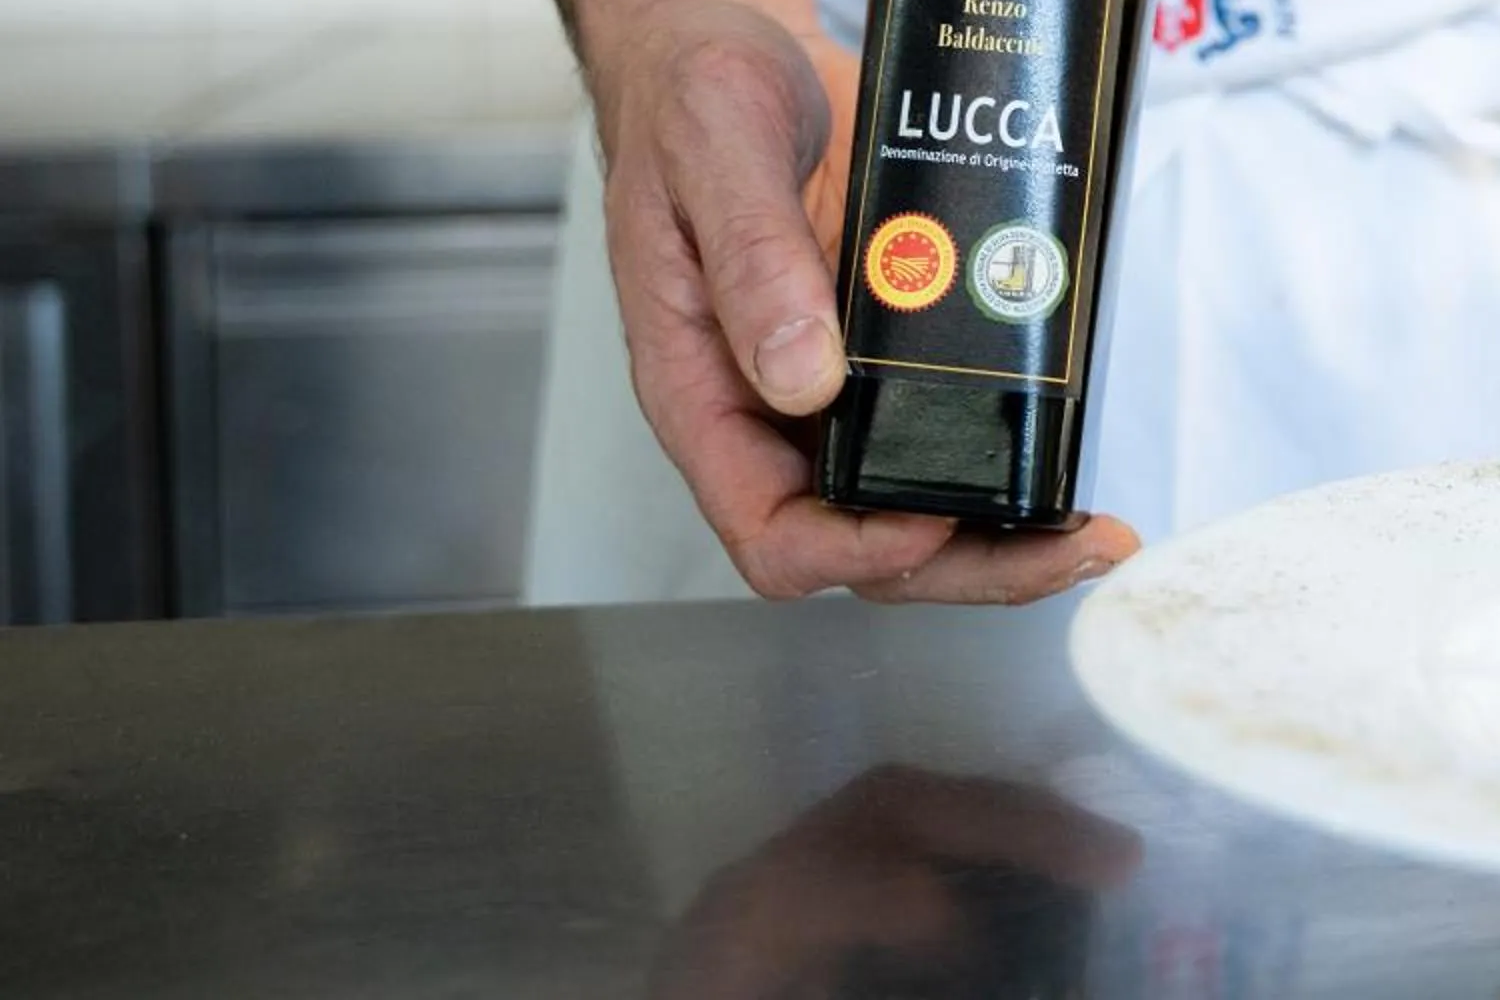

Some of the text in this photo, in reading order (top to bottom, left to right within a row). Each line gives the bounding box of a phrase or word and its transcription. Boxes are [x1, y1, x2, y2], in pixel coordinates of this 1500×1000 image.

[938, 23, 1045, 56] Baldaccin
[898, 89, 1064, 153] LUCCA
[879, 144, 967, 166] Denominazione
[969, 152, 980, 166] di
